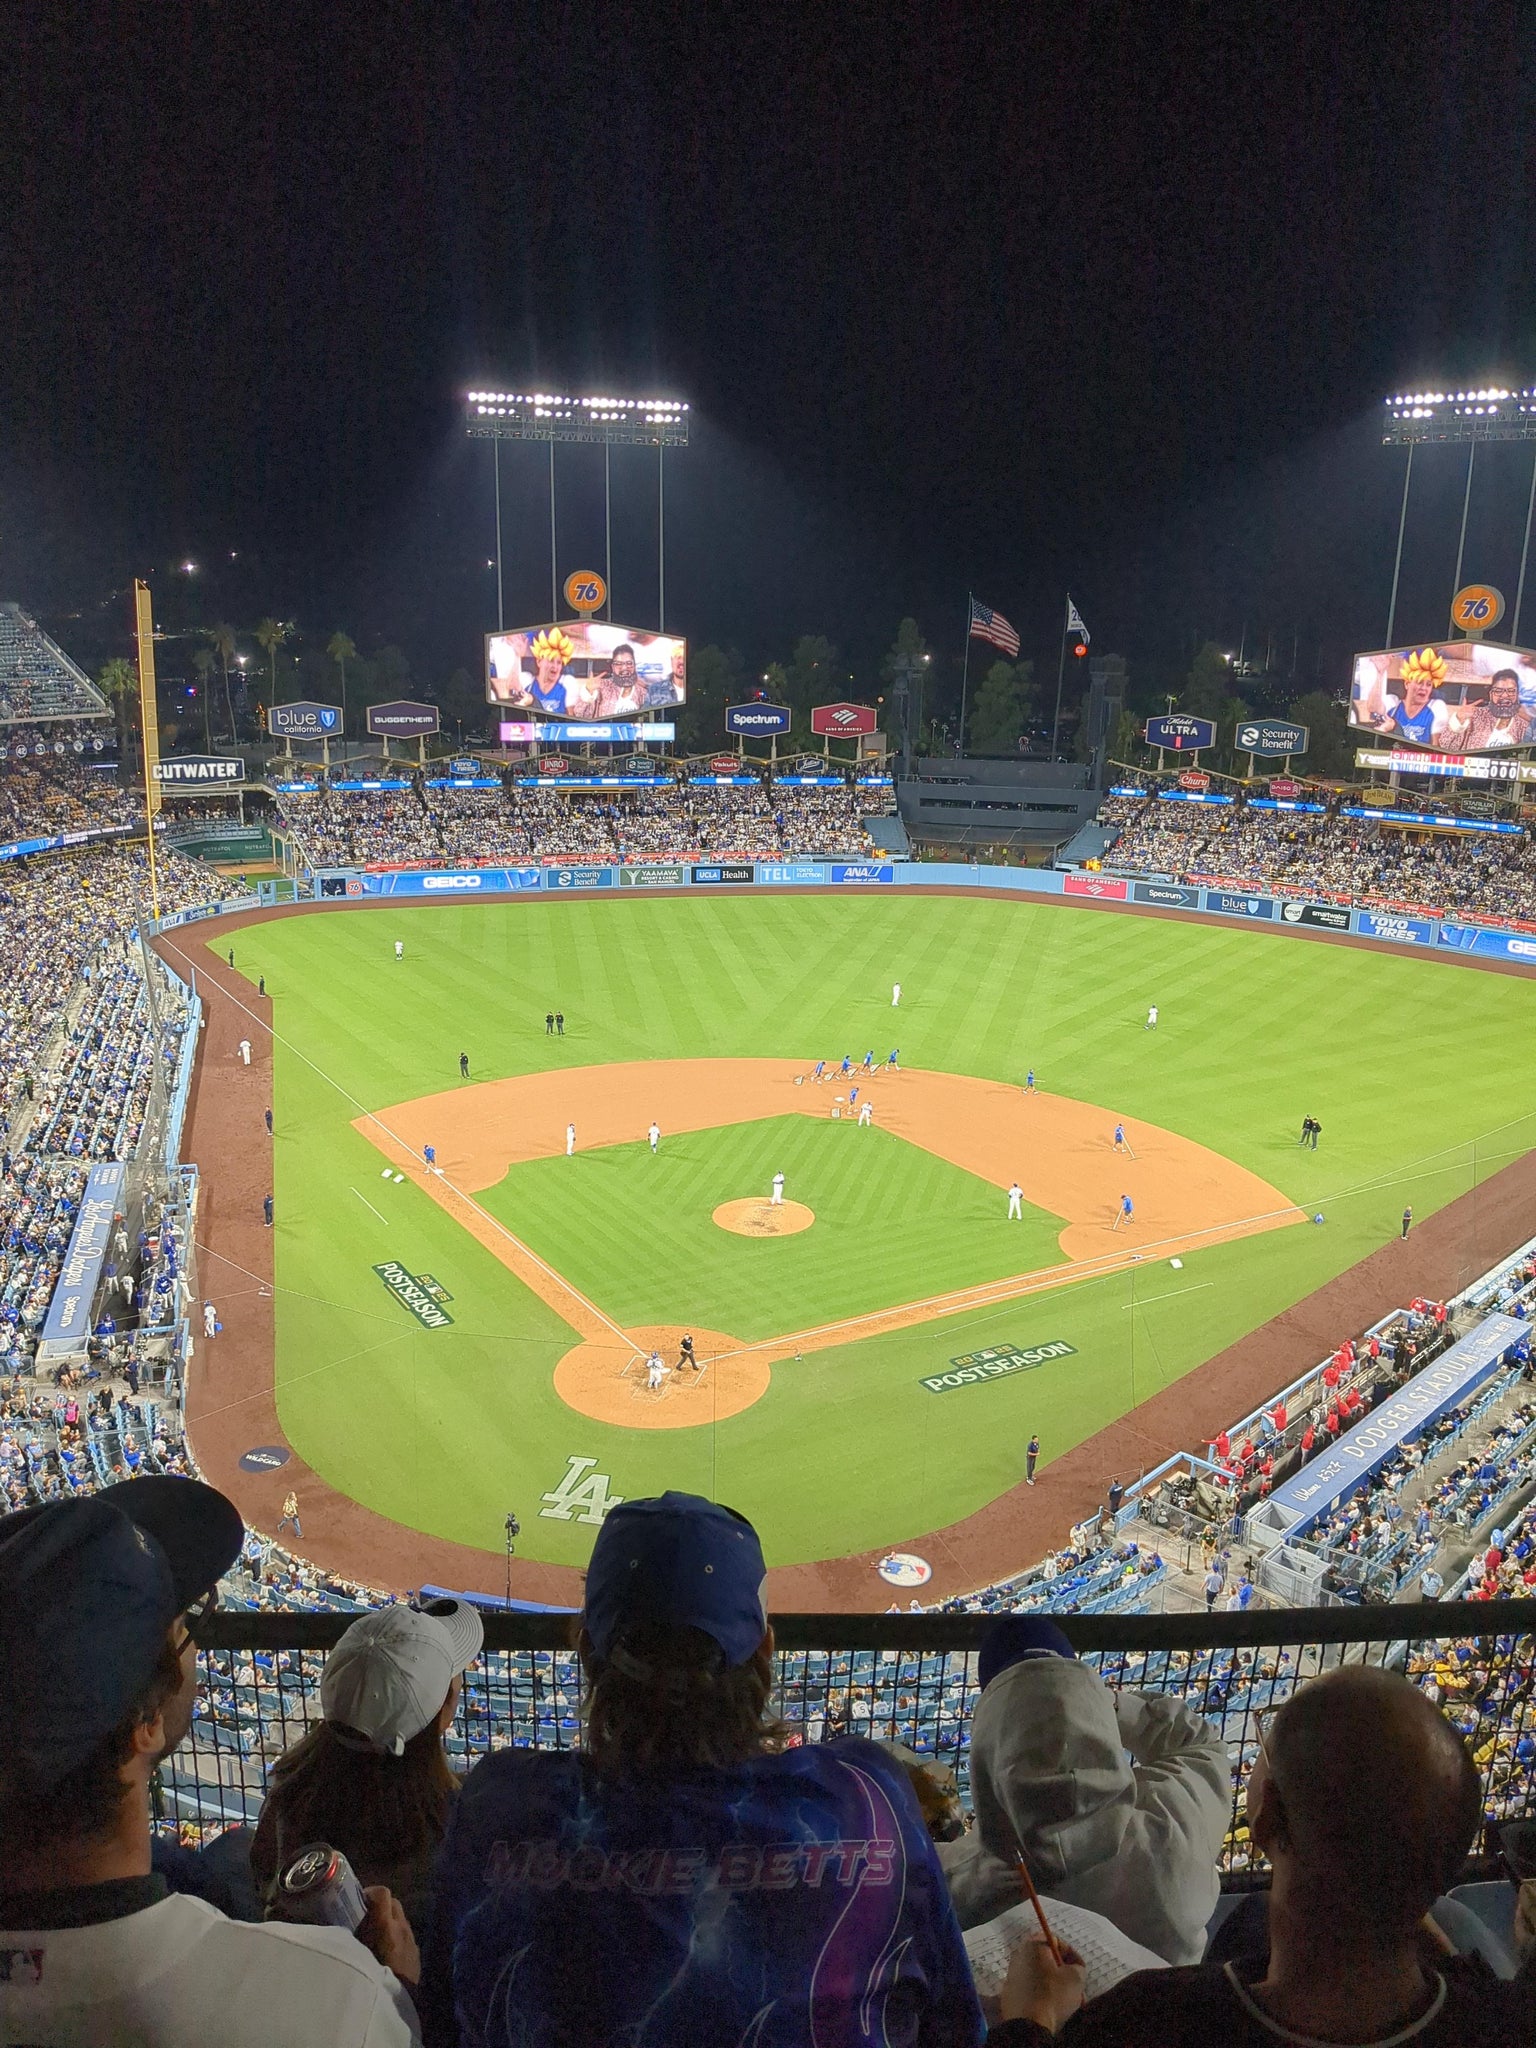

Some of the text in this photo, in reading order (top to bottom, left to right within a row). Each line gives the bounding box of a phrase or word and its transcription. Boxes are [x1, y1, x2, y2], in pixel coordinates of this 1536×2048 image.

[575, 583, 599, 601] 76
[1460, 598, 1490, 620] 76
[277, 710, 317, 725] blue
[733, 713, 780, 725] Spectrum
[1160, 725, 1198, 736] ULTRA
[1262, 729, 1300, 740] Security
[1262, 739, 1294, 749] Benefit
[152, 763, 237, 779] CUTWATER
[544, 760, 564, 769] JINRO
[1180, 775, 1208, 786] Churu
[573, 871, 601, 879] Security
[722, 870, 749, 879] Health
[762, 868, 791, 880] TEL
[844, 867, 868, 876] ANA
[350, 883, 360, 891] 76
[423, 875, 482, 888] GEICO
[1149, 889, 1182, 900] Spectrum
[1222, 896, 1247, 909] blue
[1311, 910, 1348, 920] smartwater
[1369, 916, 1408, 929] TOYO
[1374, 927, 1416, 940] TIRES
[74, 1211, 110, 1247] Angeles
[62, 1246, 103, 1287] Dodgers
[377, 1263, 450, 1327] POSTSEASON
[60, 1295, 81, 1328] Spectrum
[924, 1342, 1073, 1391] POSTSEASON
[1343, 1353, 1478, 1459] DODGER STADIUM
[537, 1454, 627, 1526] LA
[860, 1705, 866, 1714] 5
[483, 1840, 896, 1895] MOOKIE BETTS
